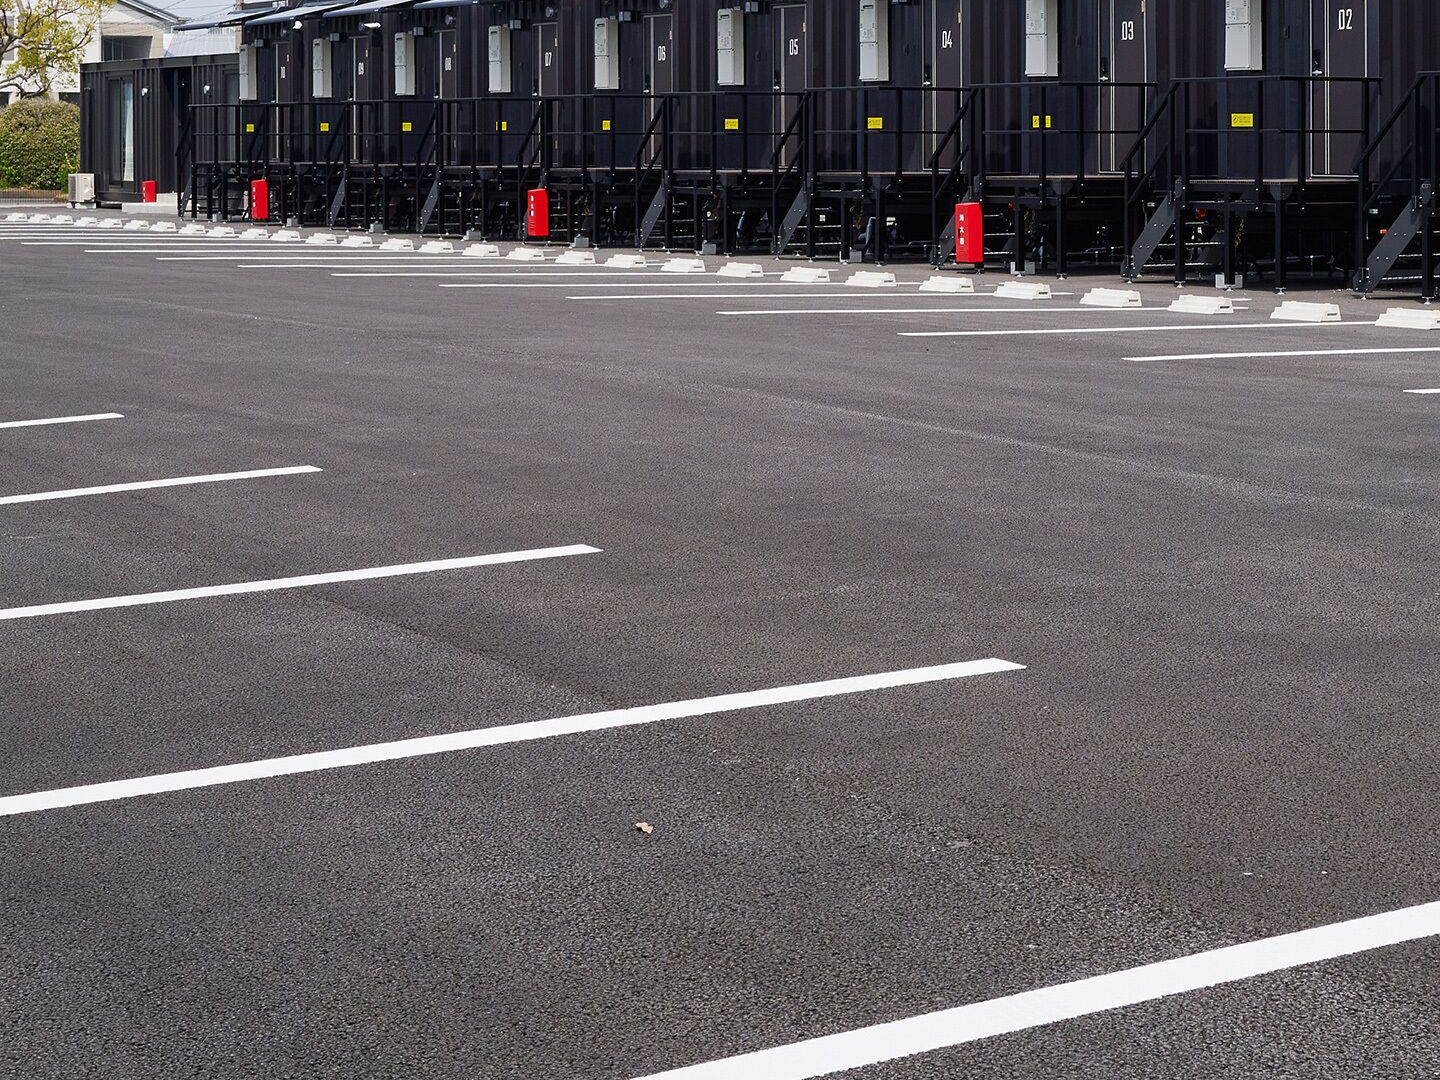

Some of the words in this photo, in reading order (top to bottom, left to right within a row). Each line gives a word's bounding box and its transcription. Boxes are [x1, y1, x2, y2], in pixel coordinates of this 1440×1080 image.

[1338, 8, 1353, 30] 02
[1121, 20, 1134, 40] 03
[789, 38, 799, 56] 05
[942, 30, 953, 49] 04
[544, 51, 552, 67] 07
[657, 45, 666, 61] 06
